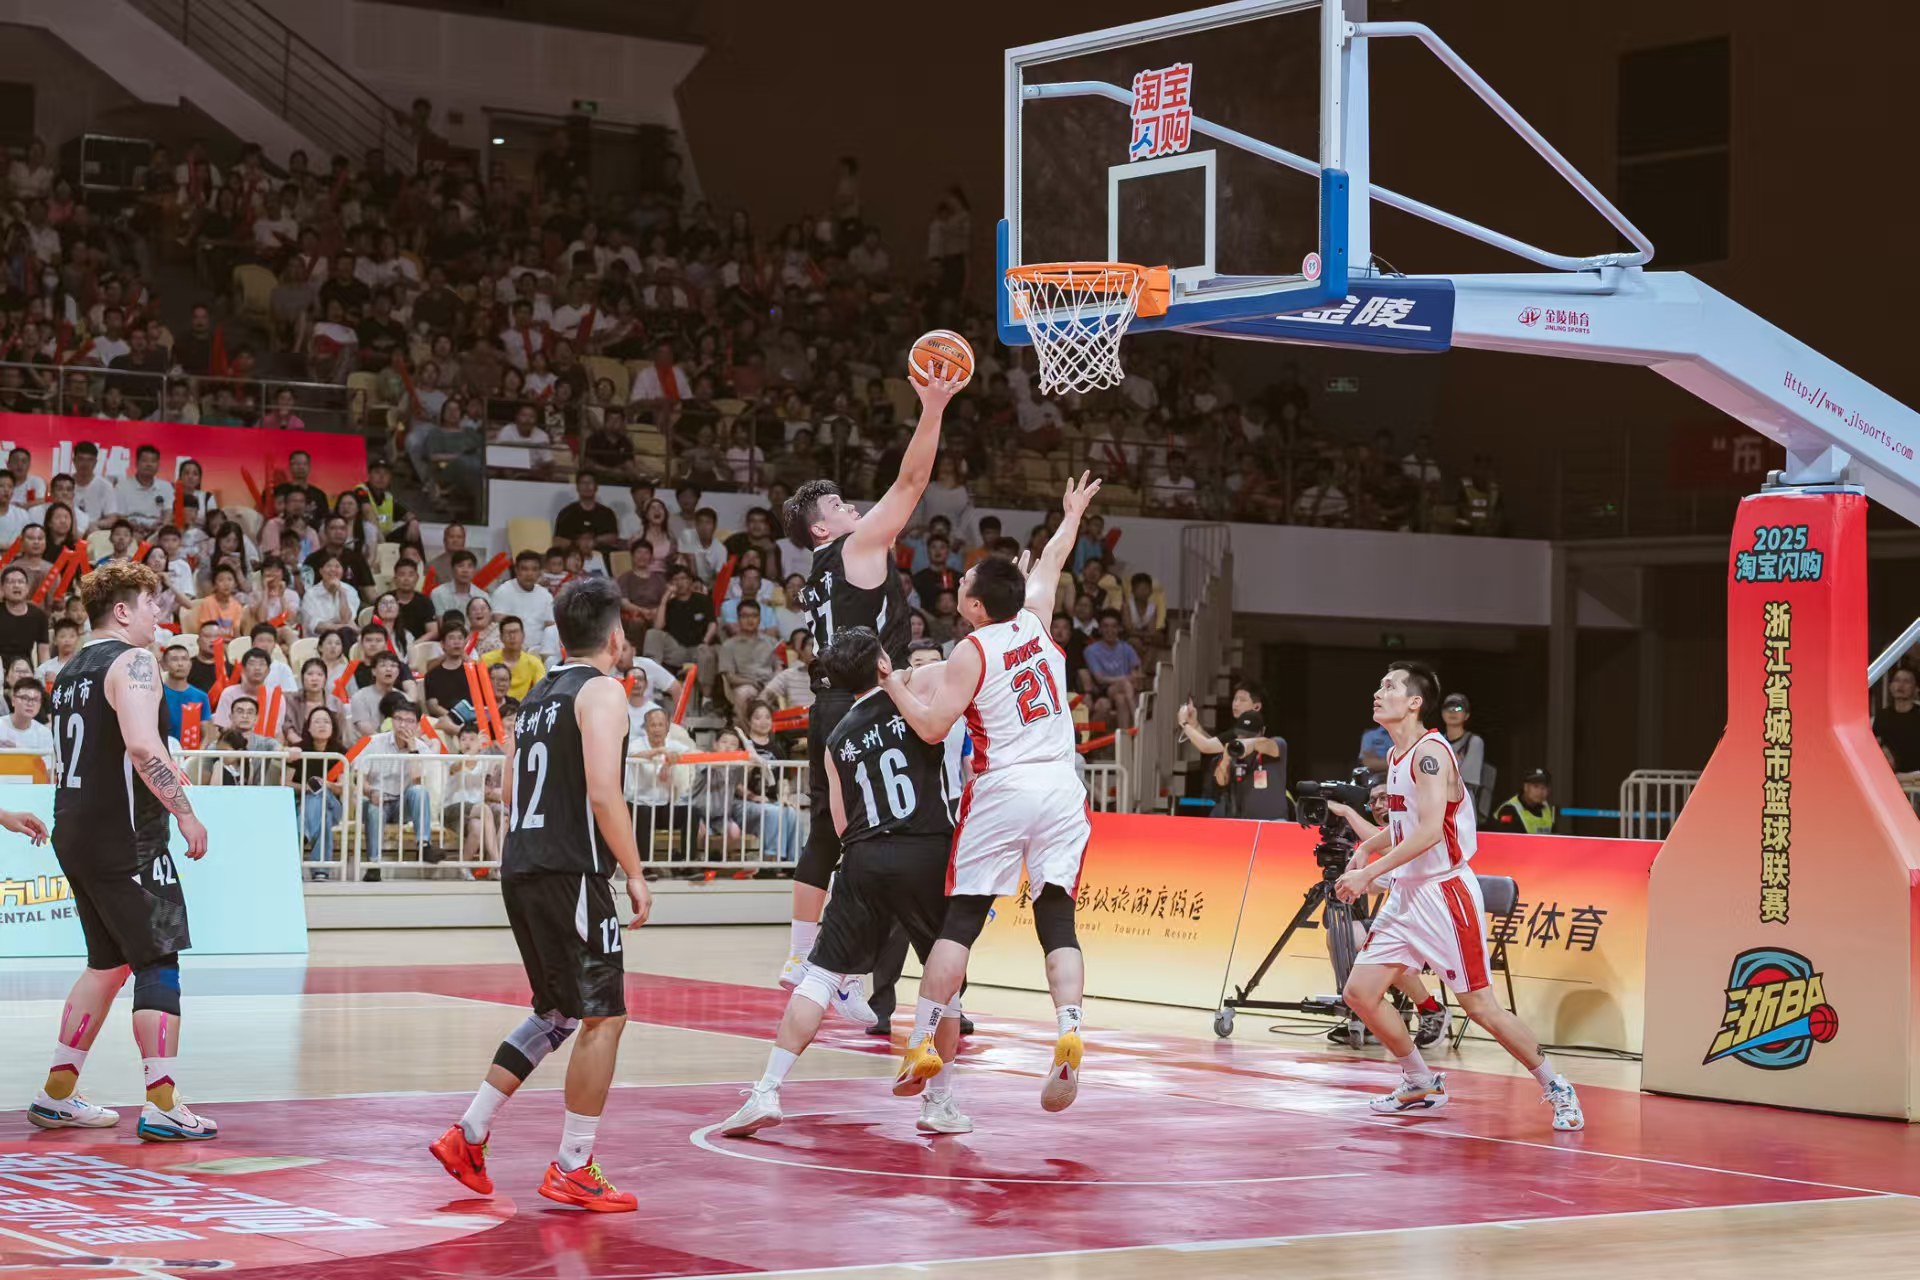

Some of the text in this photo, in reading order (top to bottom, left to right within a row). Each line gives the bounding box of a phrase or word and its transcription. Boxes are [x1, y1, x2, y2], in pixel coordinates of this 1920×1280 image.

[1133, 64, 1191, 116] 淘宝
[1131, 109, 1190, 158] 闪购
[1545, 309, 1589, 327] 金陵体育
[1545, 324, 1590, 334] JINLING SPORTS
[1783, 371, 1914, 460] Http://www.jlsports.com
[1753, 525, 1809, 552] 2025
[1735, 550, 1823, 582] 淘宝闪购
[1011, 658, 1062, 726] 21
[839, 714, 907, 763] 嵊州市
[1762, 600, 1792, 925] 浙江省城市篮球联赛
[510, 741, 548, 832] 12
[855, 747, 916, 828] 16
[152, 854, 177, 886] 42
[599, 916, 622, 954] 12
[1114, 923, 1151, 936] Tourist
[1164, 928, 1198, 940] Resort
[1706, 973, 1828, 1060] 浙BA
